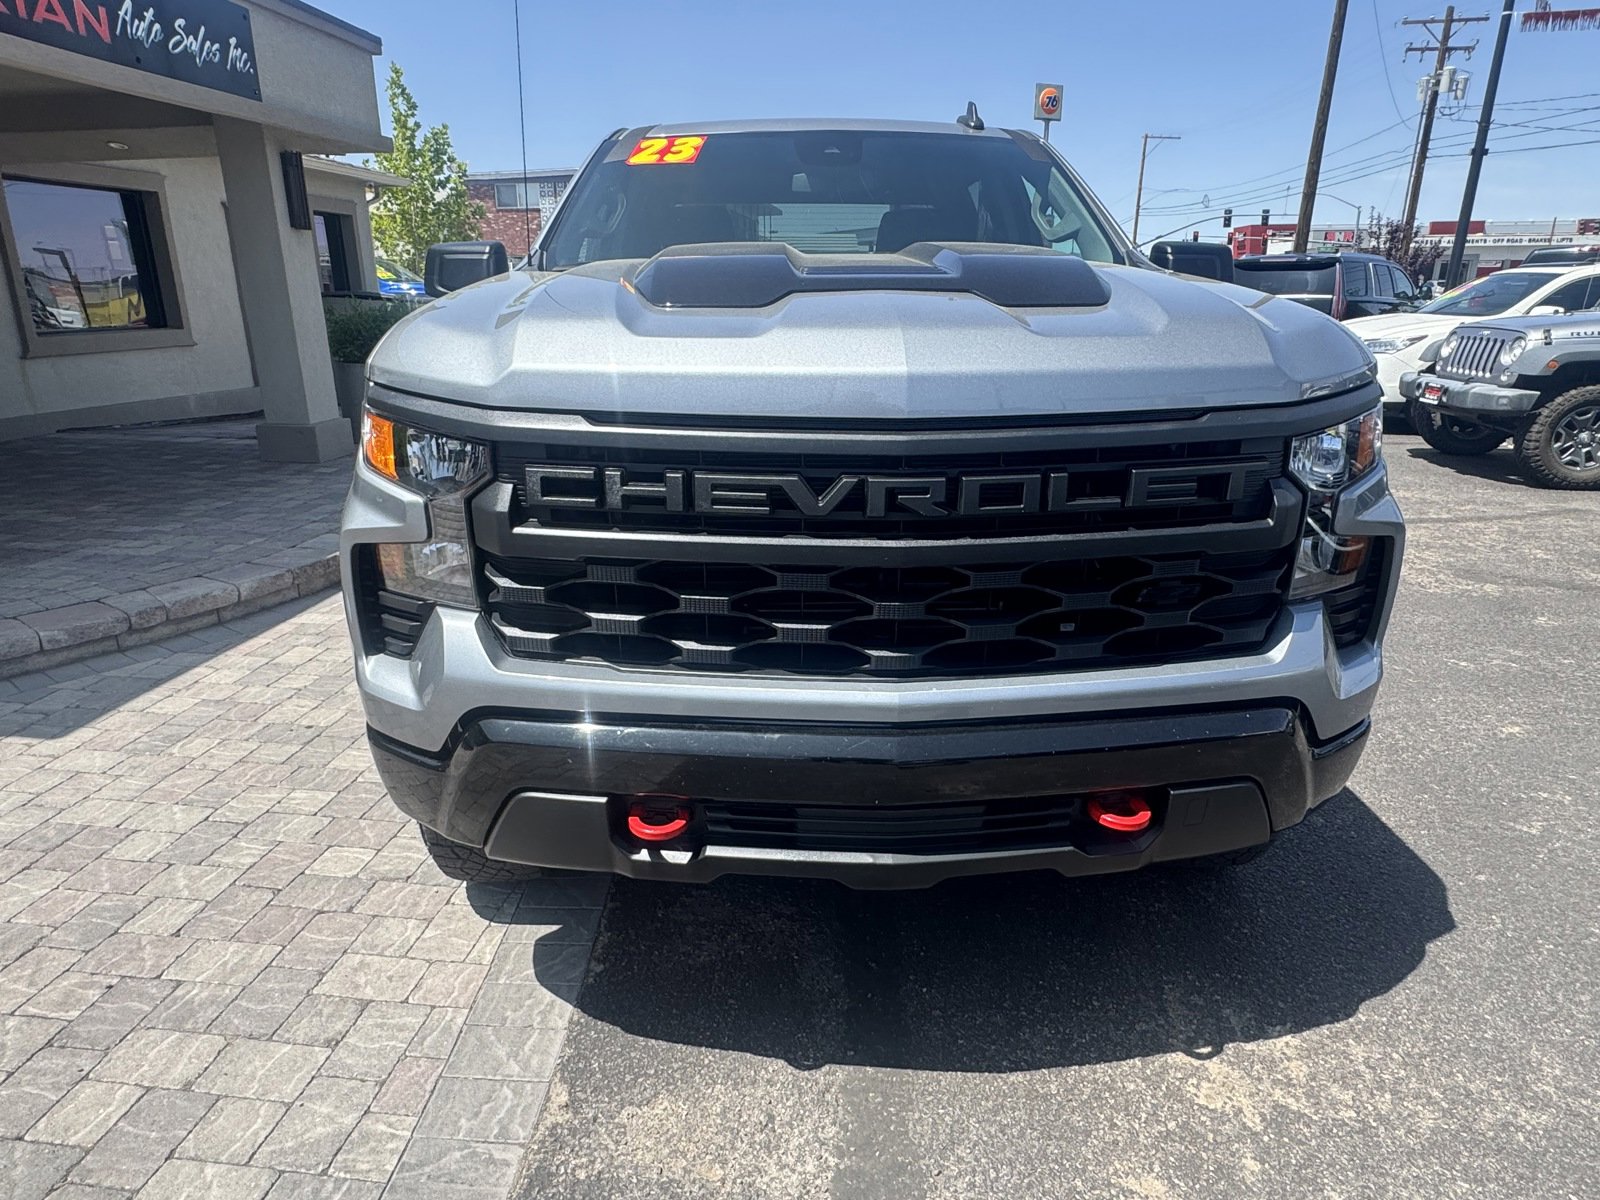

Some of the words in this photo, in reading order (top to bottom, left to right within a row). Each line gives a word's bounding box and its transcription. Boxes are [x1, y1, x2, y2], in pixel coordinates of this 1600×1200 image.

[115, 0, 164, 48] Auto
[168, 18, 220, 67] Sales
[227, 37, 254, 74] Inc.
[1045, 94, 1058, 108] 76
[629, 136, 703, 163] 23
[525, 461, 1267, 517] CHEVROLET
